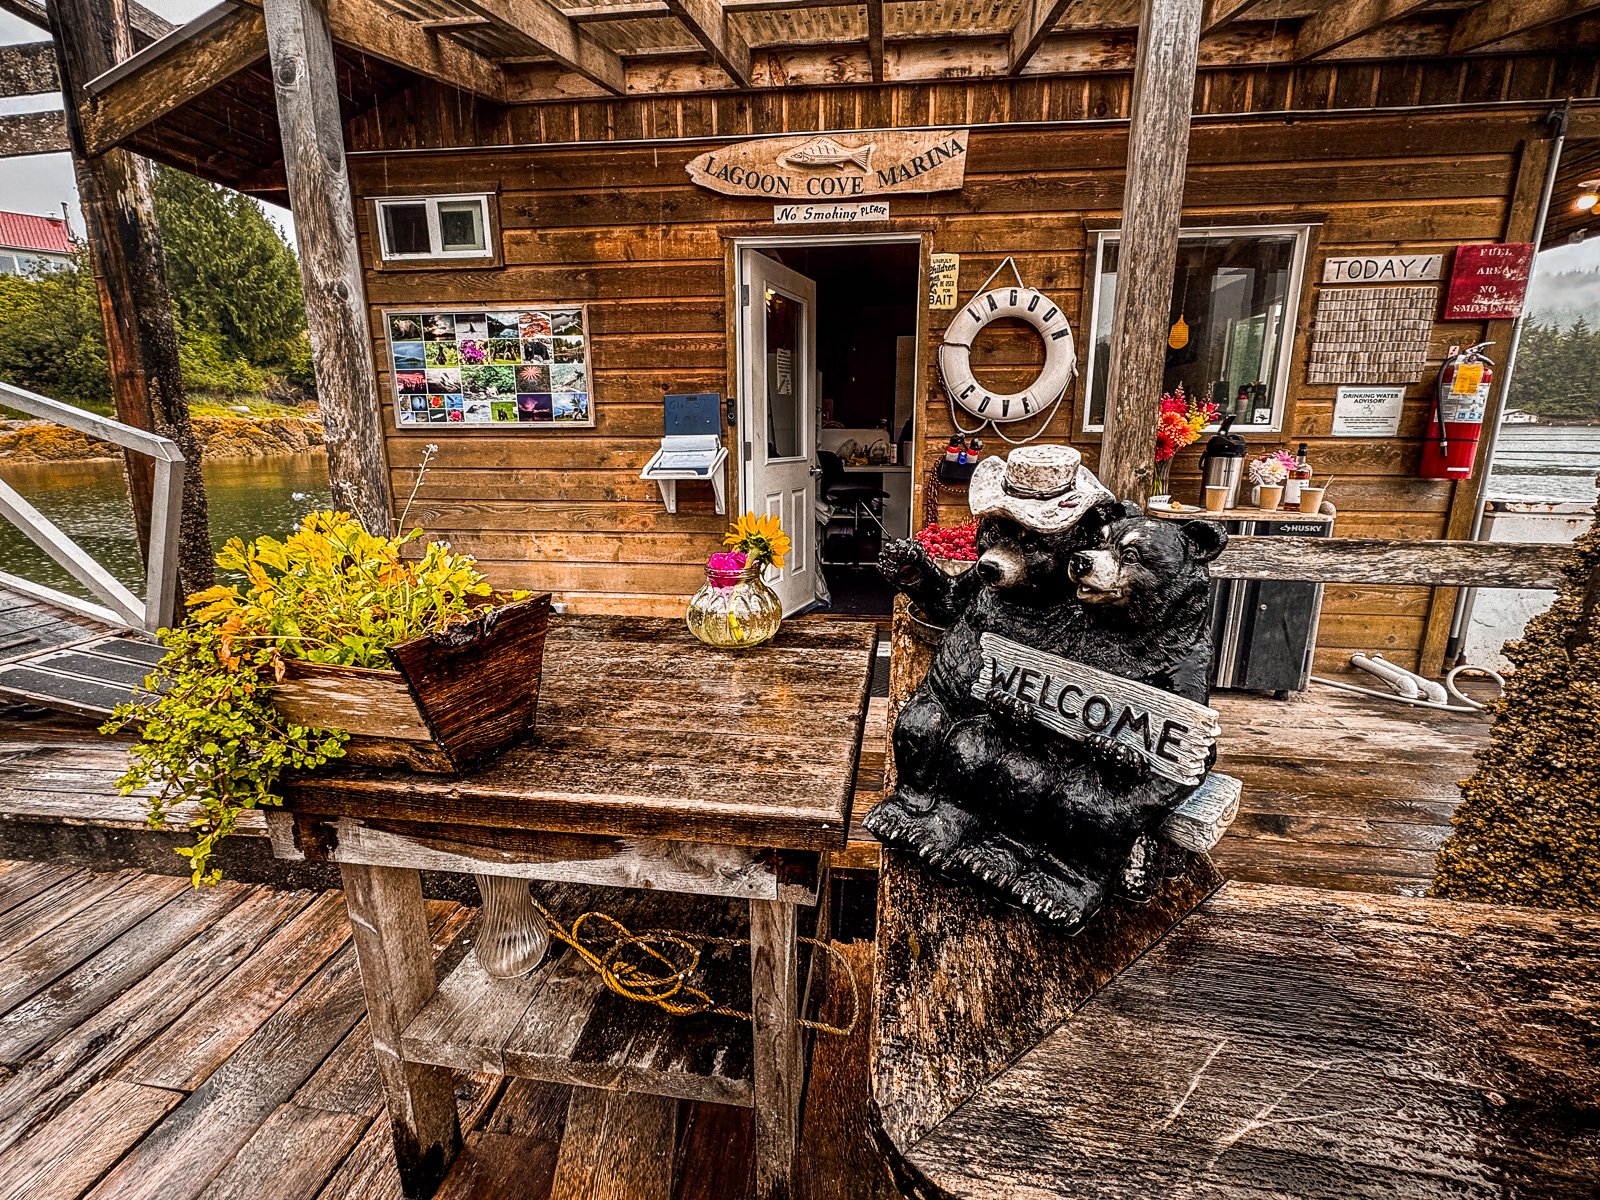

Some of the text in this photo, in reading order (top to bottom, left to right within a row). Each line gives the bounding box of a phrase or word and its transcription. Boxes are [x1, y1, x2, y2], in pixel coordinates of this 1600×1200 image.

[704, 138, 965, 196] LAGOON COVE MARINA
[777, 204, 887, 221] No Smoking PLEASE
[1480, 246, 1514, 257] FUEL
[1332, 257, 1433, 280] TODAY!
[929, 295, 953, 305] BAIT
[1480, 285, 1497, 294] NO
[967, 290, 1069, 341] LAGOON
[960, 384, 1031, 417] COVE
[992, 657, 1188, 762] WELCOME
